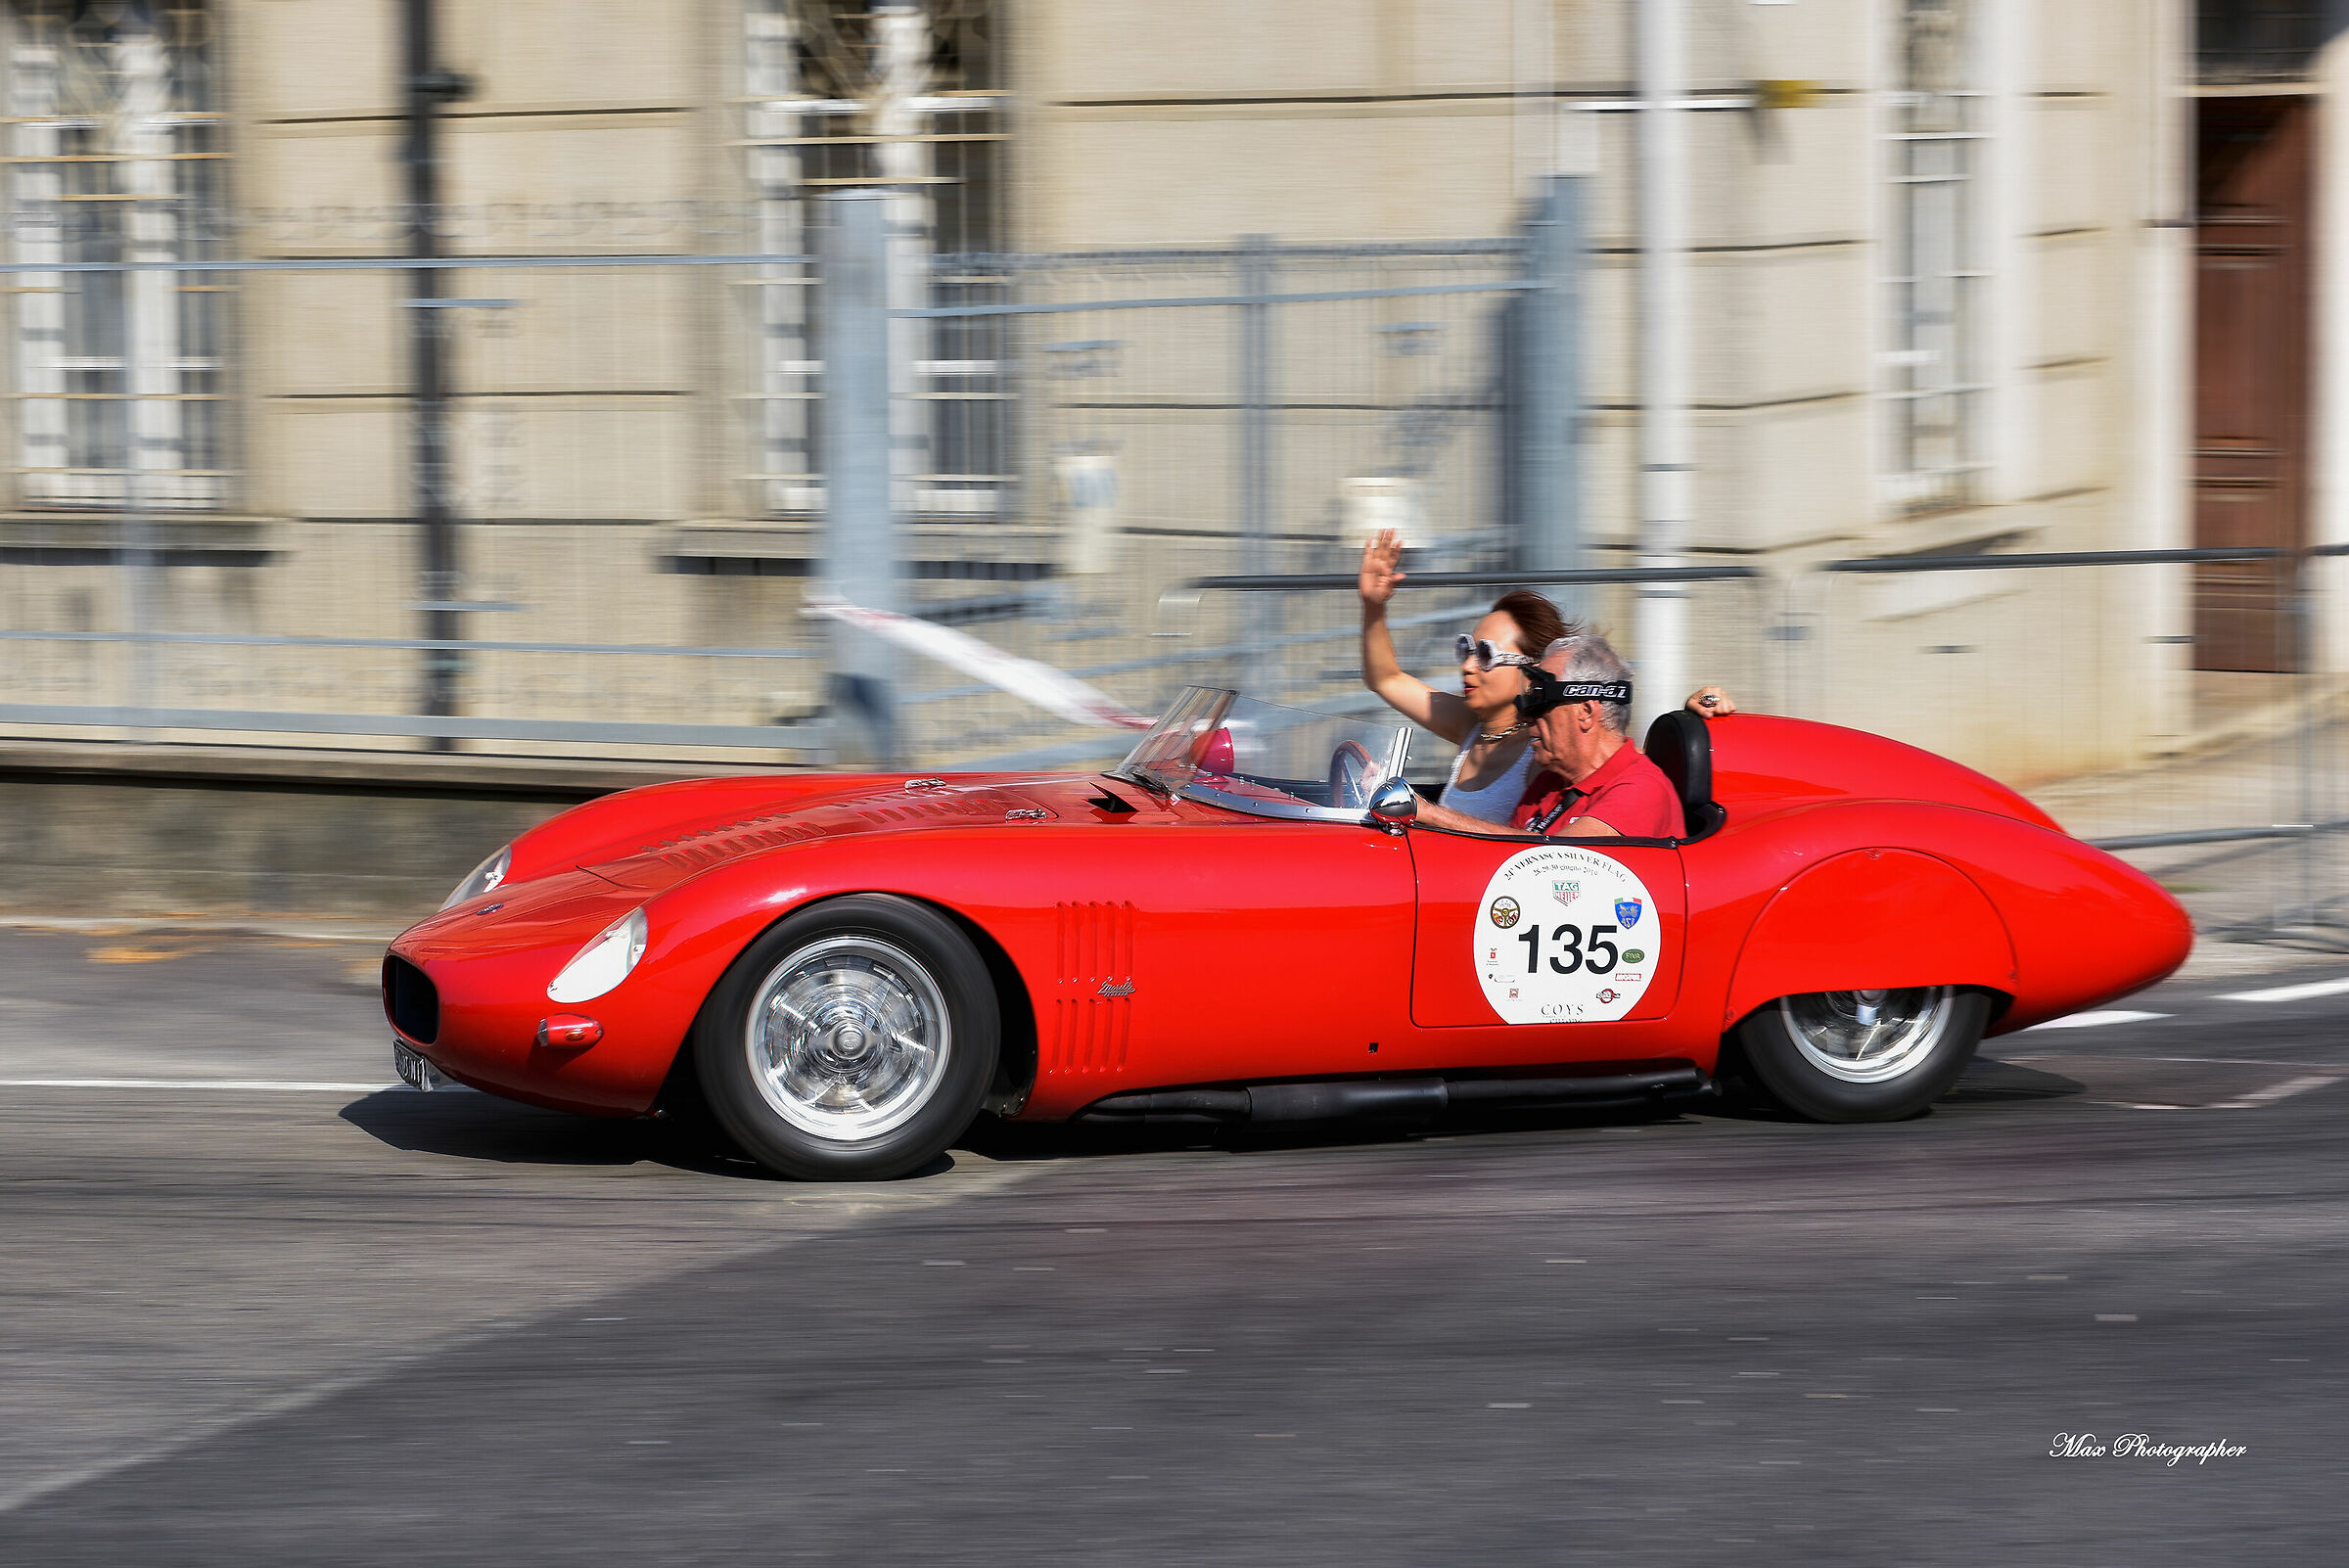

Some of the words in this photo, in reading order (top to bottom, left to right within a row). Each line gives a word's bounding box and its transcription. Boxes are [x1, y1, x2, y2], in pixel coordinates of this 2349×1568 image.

[1513, 852, 1563, 870] VERNASCA
[1563, 852, 1600, 866] SILVER
[1601, 861, 1627, 883] FLAG
[1554, 882, 1580, 891] TAG
[1518, 923, 1619, 975] 135
[1541, 1003, 1584, 1016] COYS
